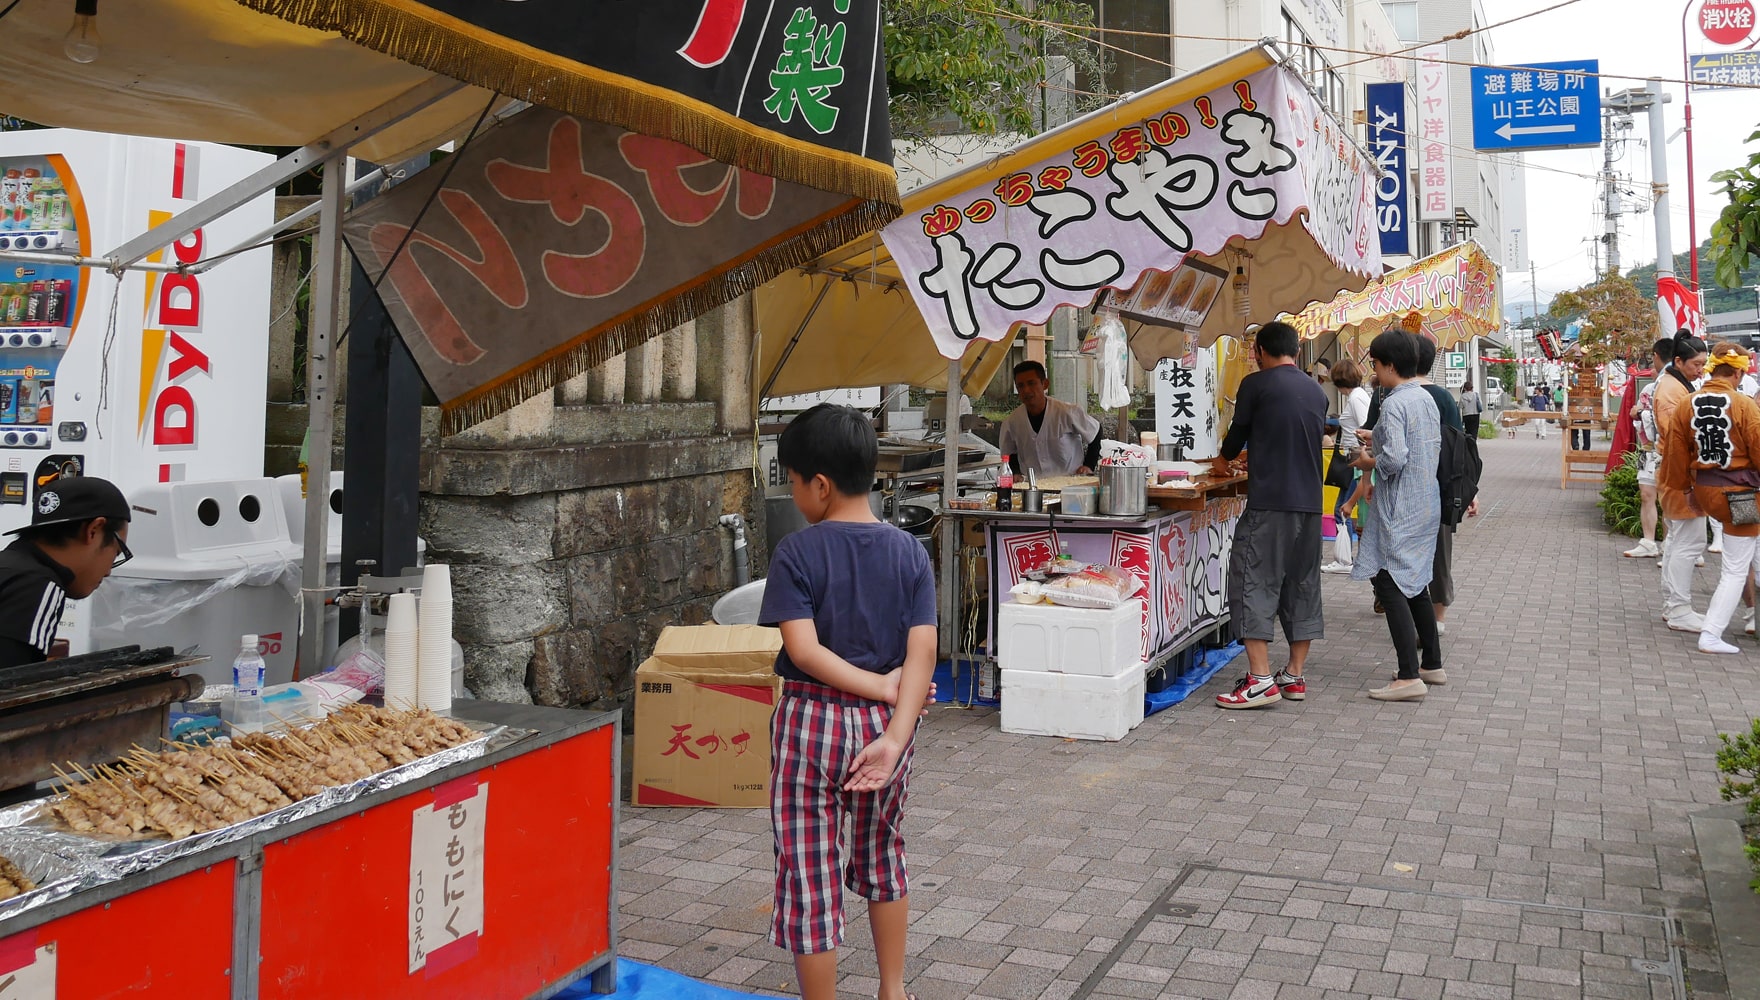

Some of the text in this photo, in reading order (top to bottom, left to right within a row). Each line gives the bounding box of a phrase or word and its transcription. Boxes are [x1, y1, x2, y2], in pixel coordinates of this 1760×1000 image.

[1702, 7, 1752, 30] 消火栓
[763, 0, 851, 134] 製
[1720, 53, 1760, 66] 山王さ
[1483, 68, 1587, 96] 避難場所
[1492, 95, 1580, 120] 山王公園
[1421, 51, 1447, 212] エゾヤ洋食器店
[1375, 104, 1401, 233] SONY
[918, 106, 1298, 341] たこやき
[1452, 355, 1464, 367] P
[641, 682, 672, 694] 業務用
[660, 723, 751, 760] 天かす
[443, 802, 467, 939] ももにく
